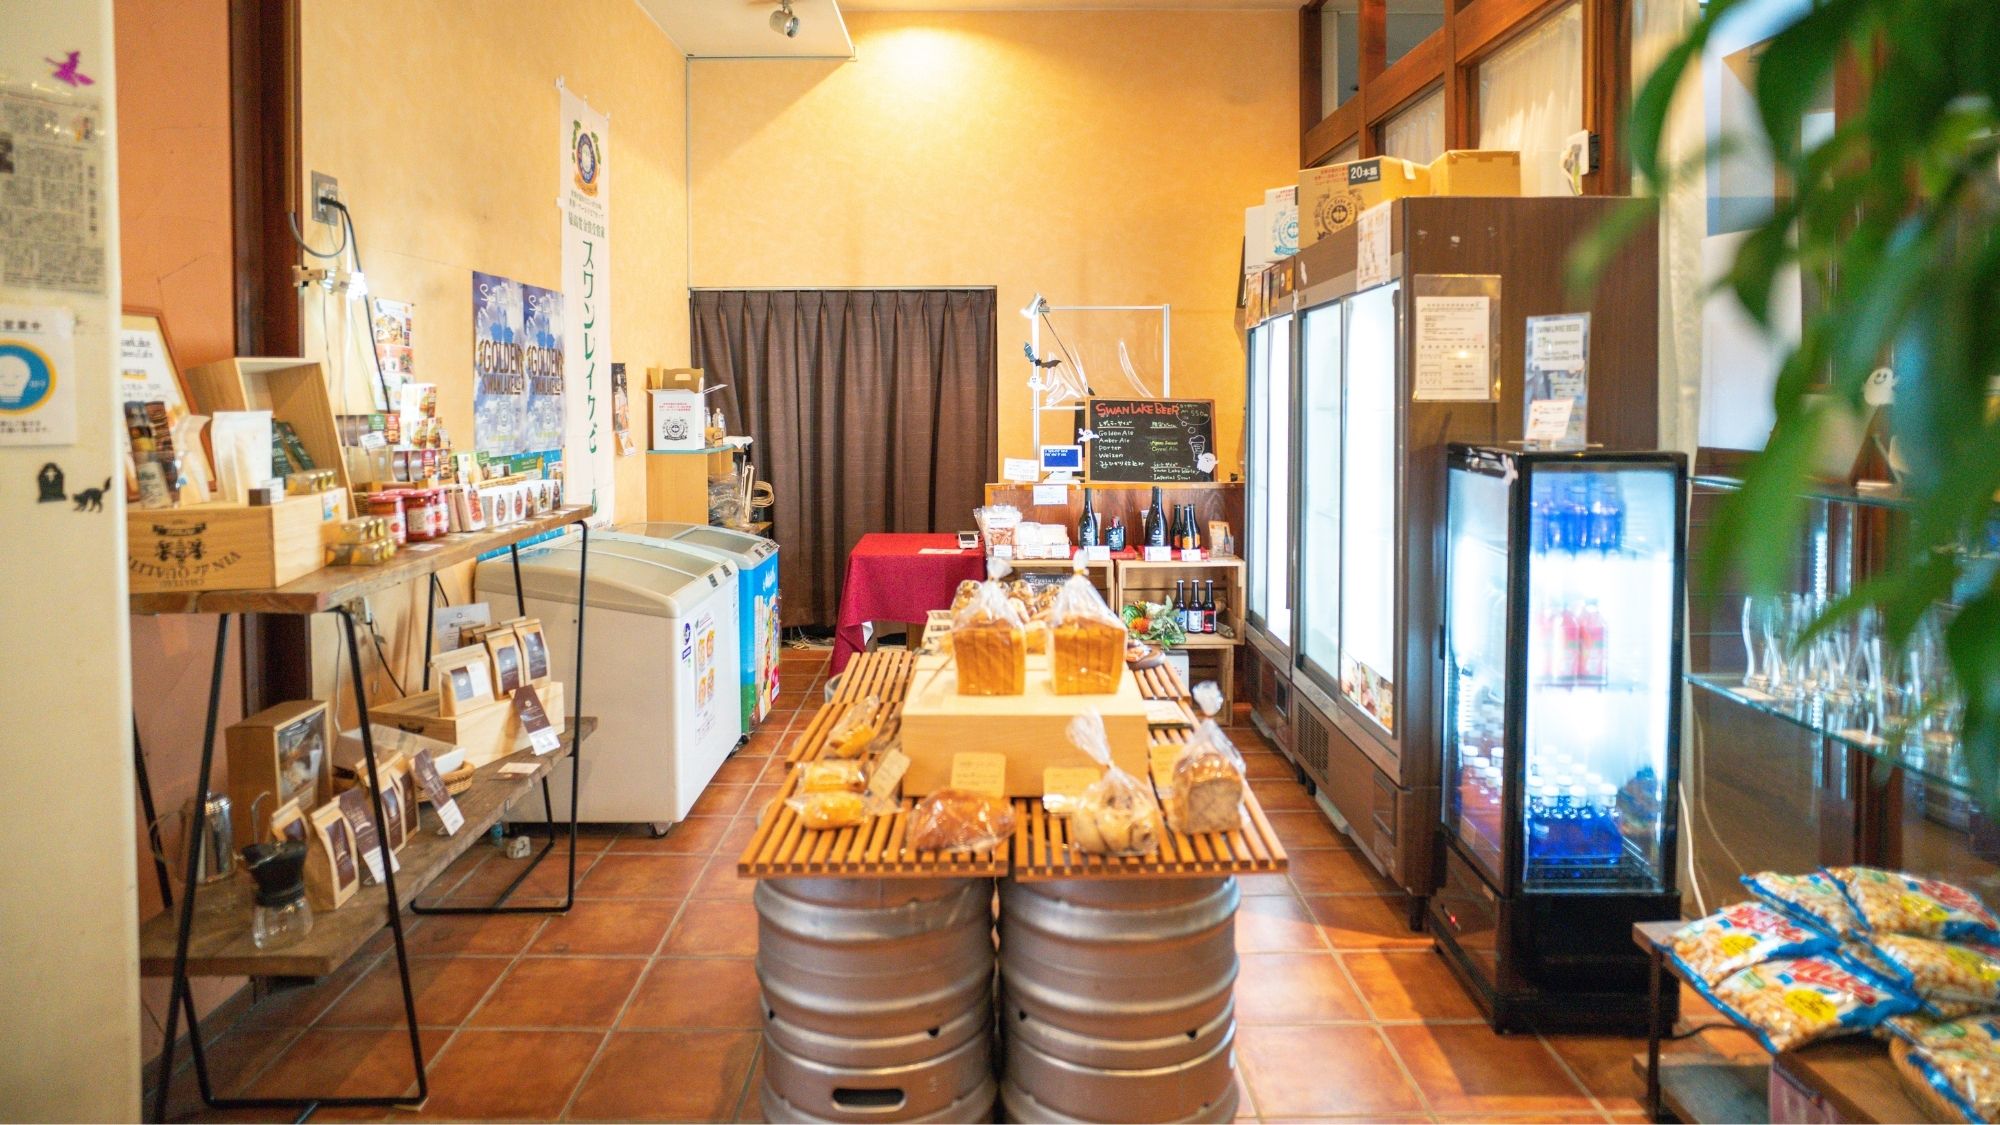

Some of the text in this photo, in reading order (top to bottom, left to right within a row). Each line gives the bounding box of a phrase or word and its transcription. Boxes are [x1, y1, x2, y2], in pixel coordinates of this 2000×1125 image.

[484, 340, 522, 374] GOLDEN
[532, 346, 562, 377] GOLDEN
[1096, 403, 1129, 417] SWAN
[1131, 403, 1153, 414] LAKE
[1154, 402, 1180, 415] BEER
